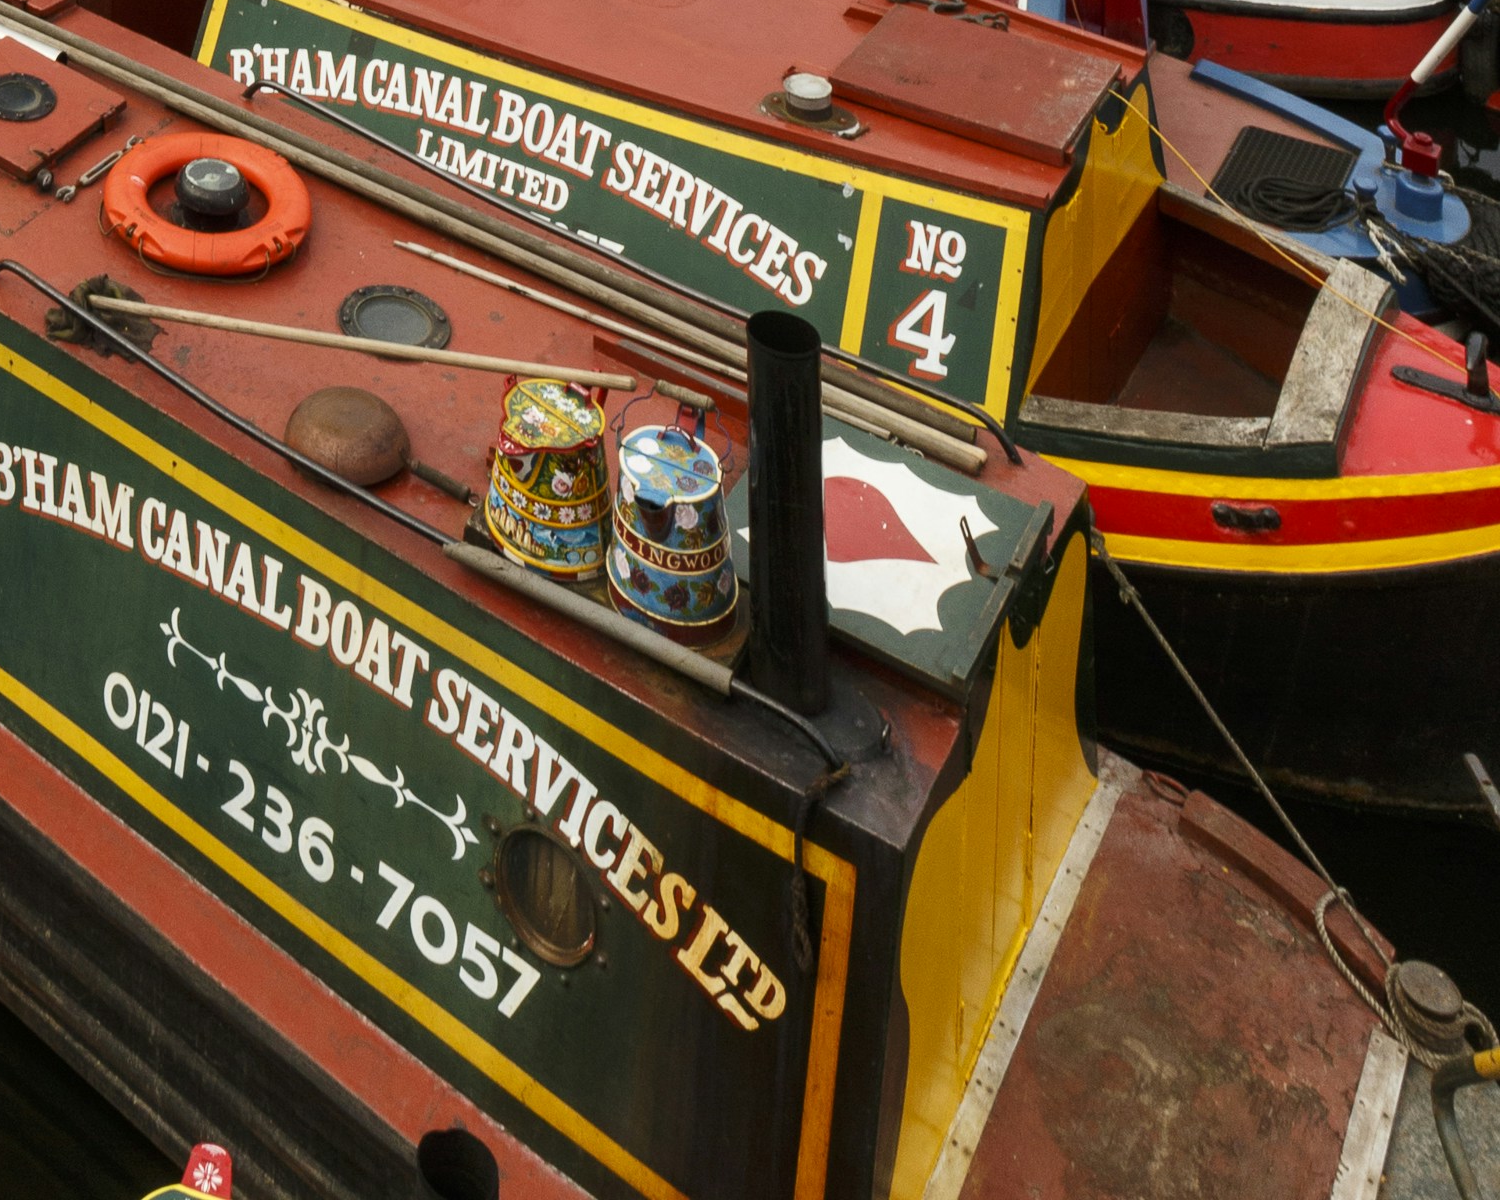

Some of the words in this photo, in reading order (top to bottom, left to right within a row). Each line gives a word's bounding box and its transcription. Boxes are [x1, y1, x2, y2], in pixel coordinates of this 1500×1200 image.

[229, 43, 358, 102] B'HAM
[362, 58, 490, 136] CANAL
[491, 88, 612, 179] BOAT
[605, 141, 828, 306] SERVICES
[416, 128, 569, 213] LIMITED
[895, 288, 957, 377] 4
[139, 496, 293, 630] CANAL
[294, 573, 430, 709] BOAT
[426, 667, 698, 942] SERVICES
[676, 903, 788, 1032] LTD
